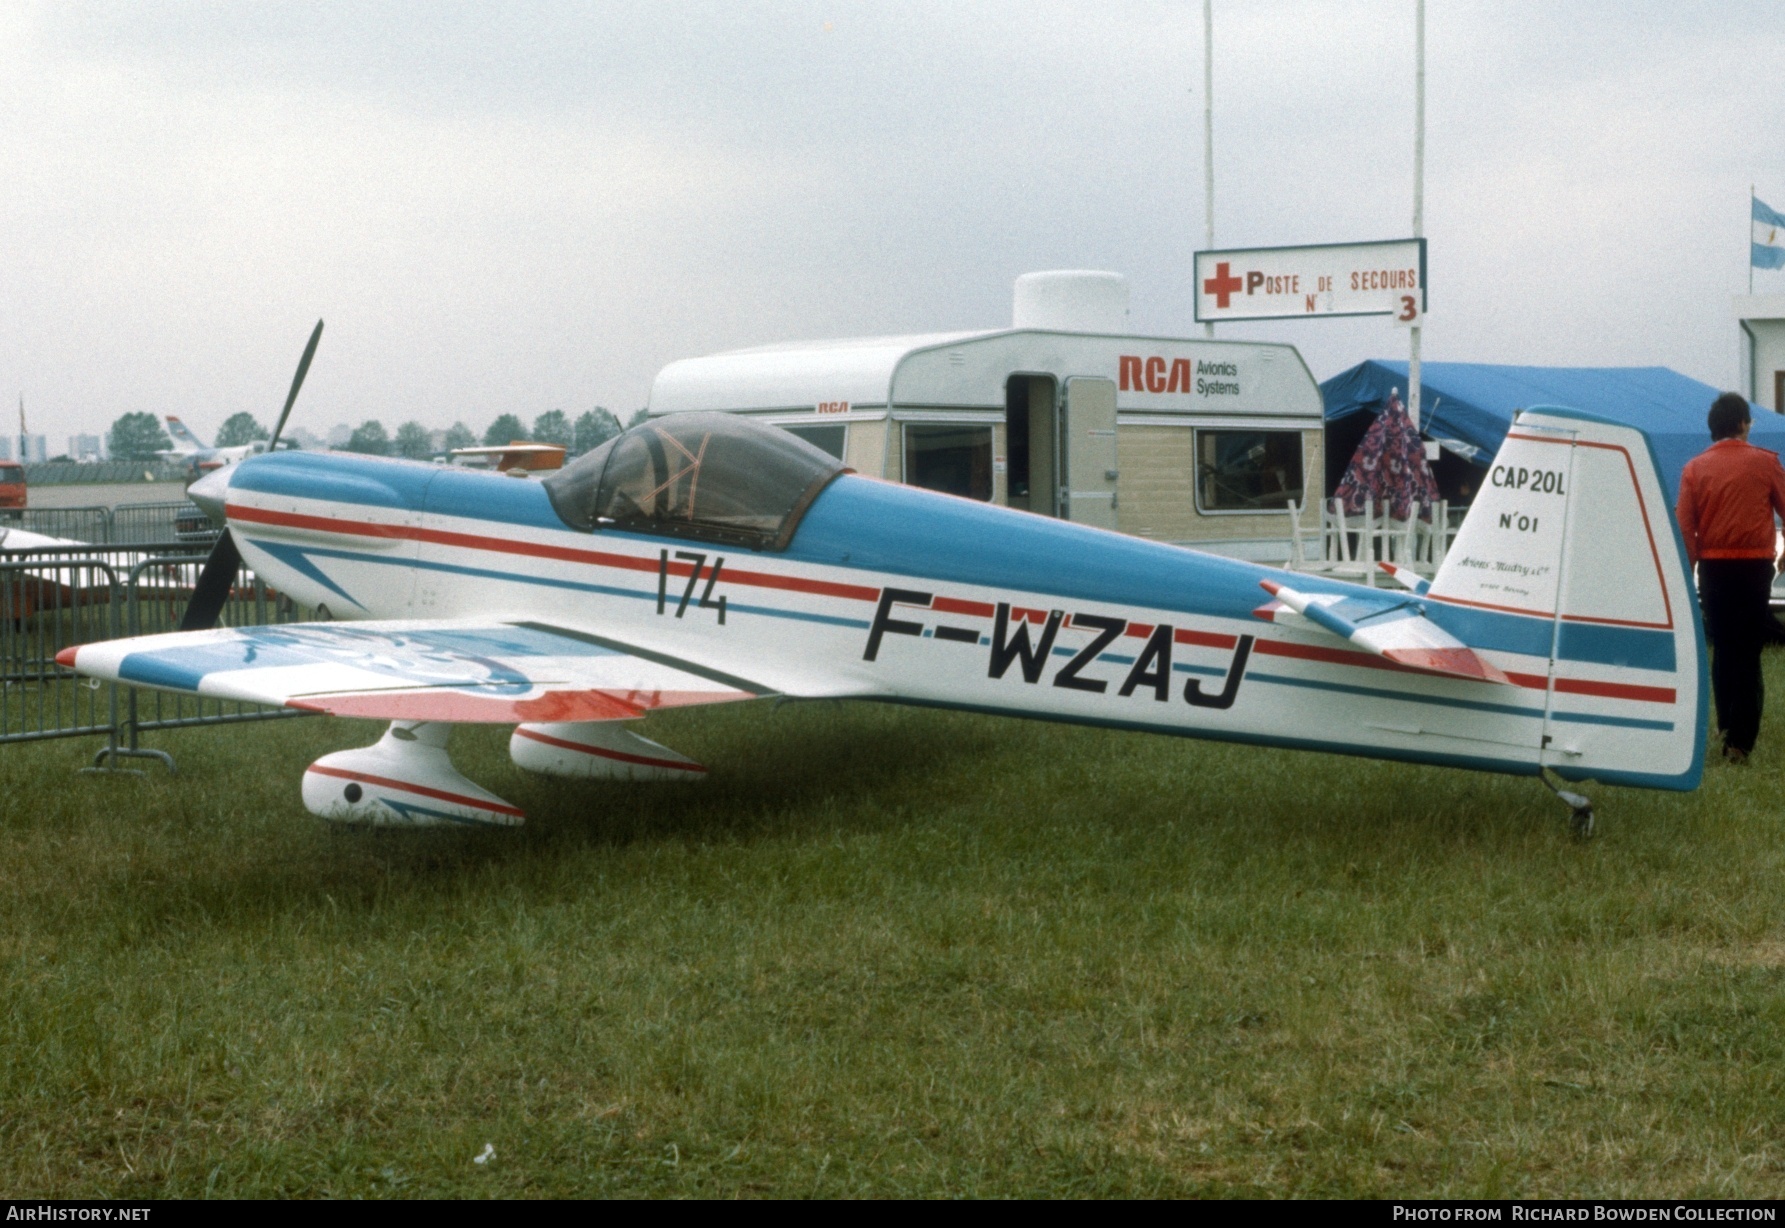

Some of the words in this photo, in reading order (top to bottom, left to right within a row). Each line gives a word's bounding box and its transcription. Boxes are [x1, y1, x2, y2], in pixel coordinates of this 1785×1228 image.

[1318, 276, 1333, 292] DE
[1351, 269, 1416, 291] SECOURS
[1399, 295, 1417, 322] 3
[1119, 355, 1191, 394] RCA
[1197, 359, 1237, 376] Avionics
[1197, 378, 1239, 397] Systems
[818, 401, 849, 414] RCA
[657, 548, 727, 626] 174
[863, 587, 1254, 710] F-WZAJ
